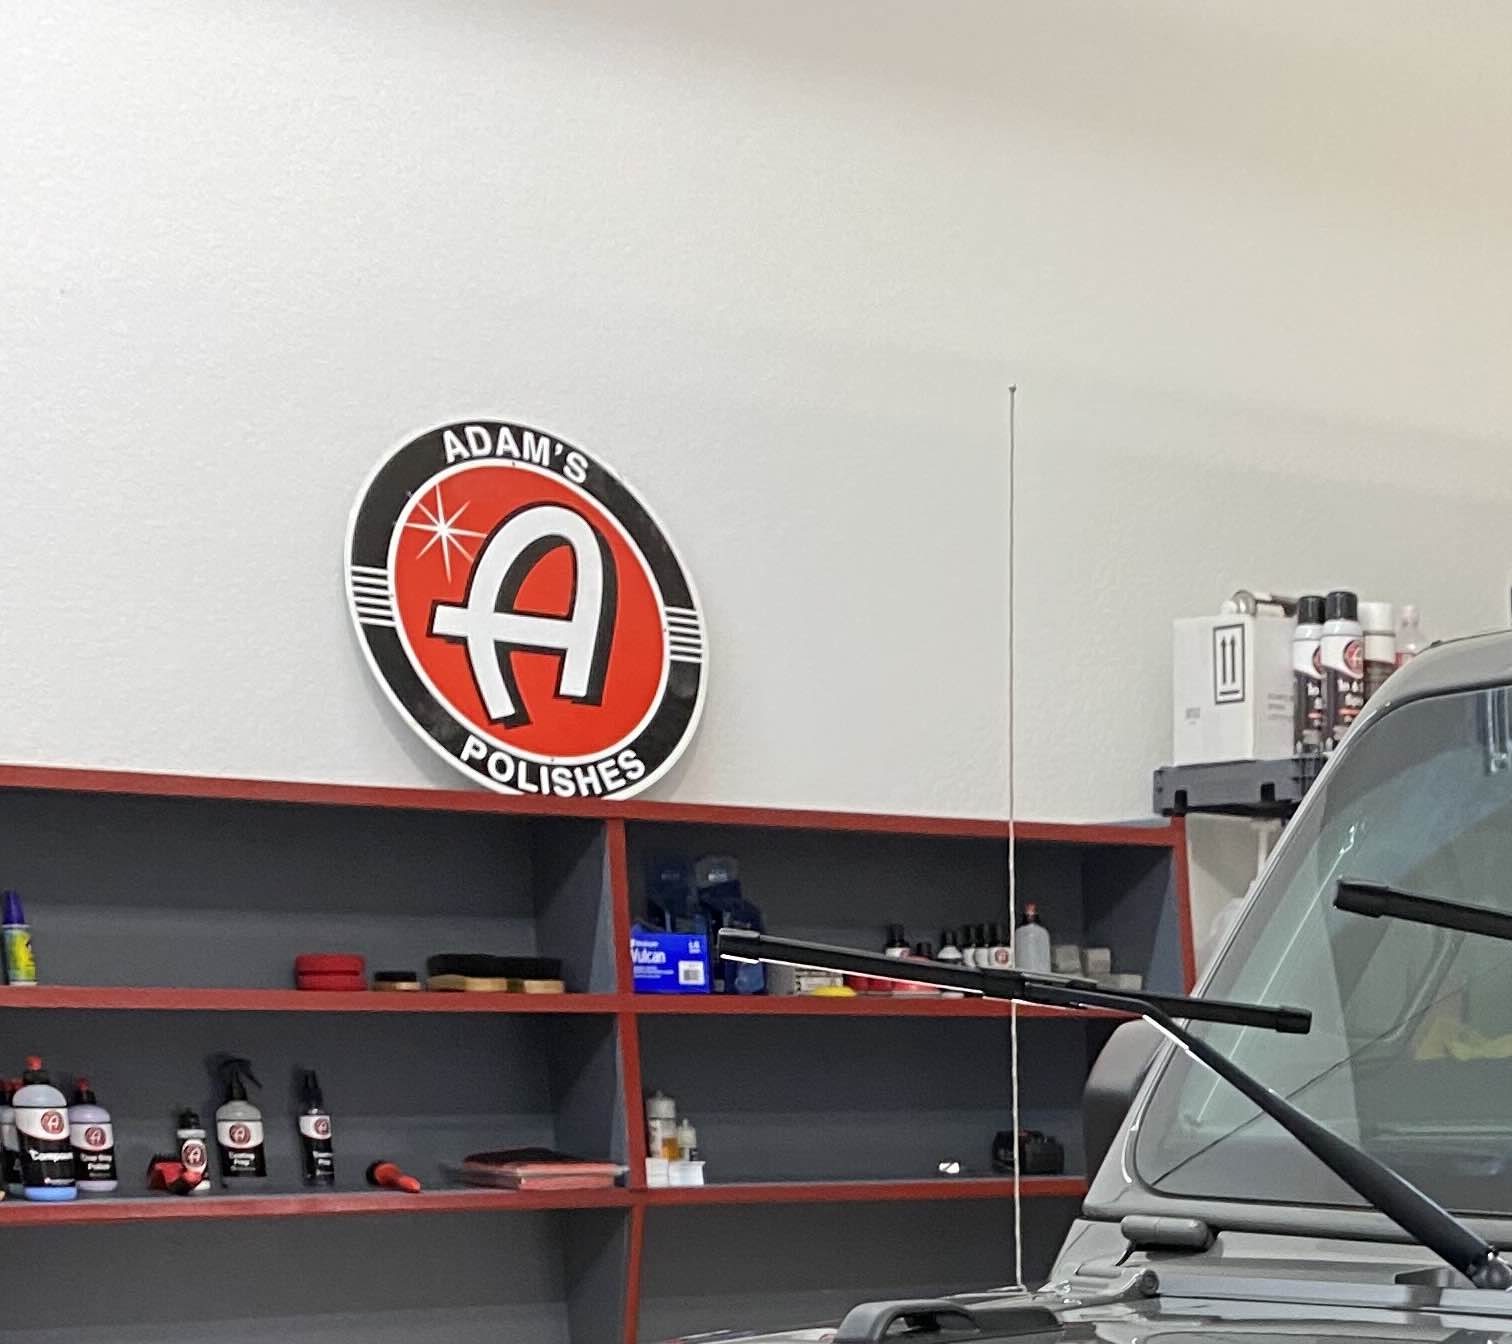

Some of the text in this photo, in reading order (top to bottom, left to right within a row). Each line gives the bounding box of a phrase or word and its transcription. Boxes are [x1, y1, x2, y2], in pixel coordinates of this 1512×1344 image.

[442, 425, 589, 484] ADAM'S
[431, 503, 617, 728] A
[460, 735, 646, 798] POLISHES
[631, 948, 667, 965] Vulcan
